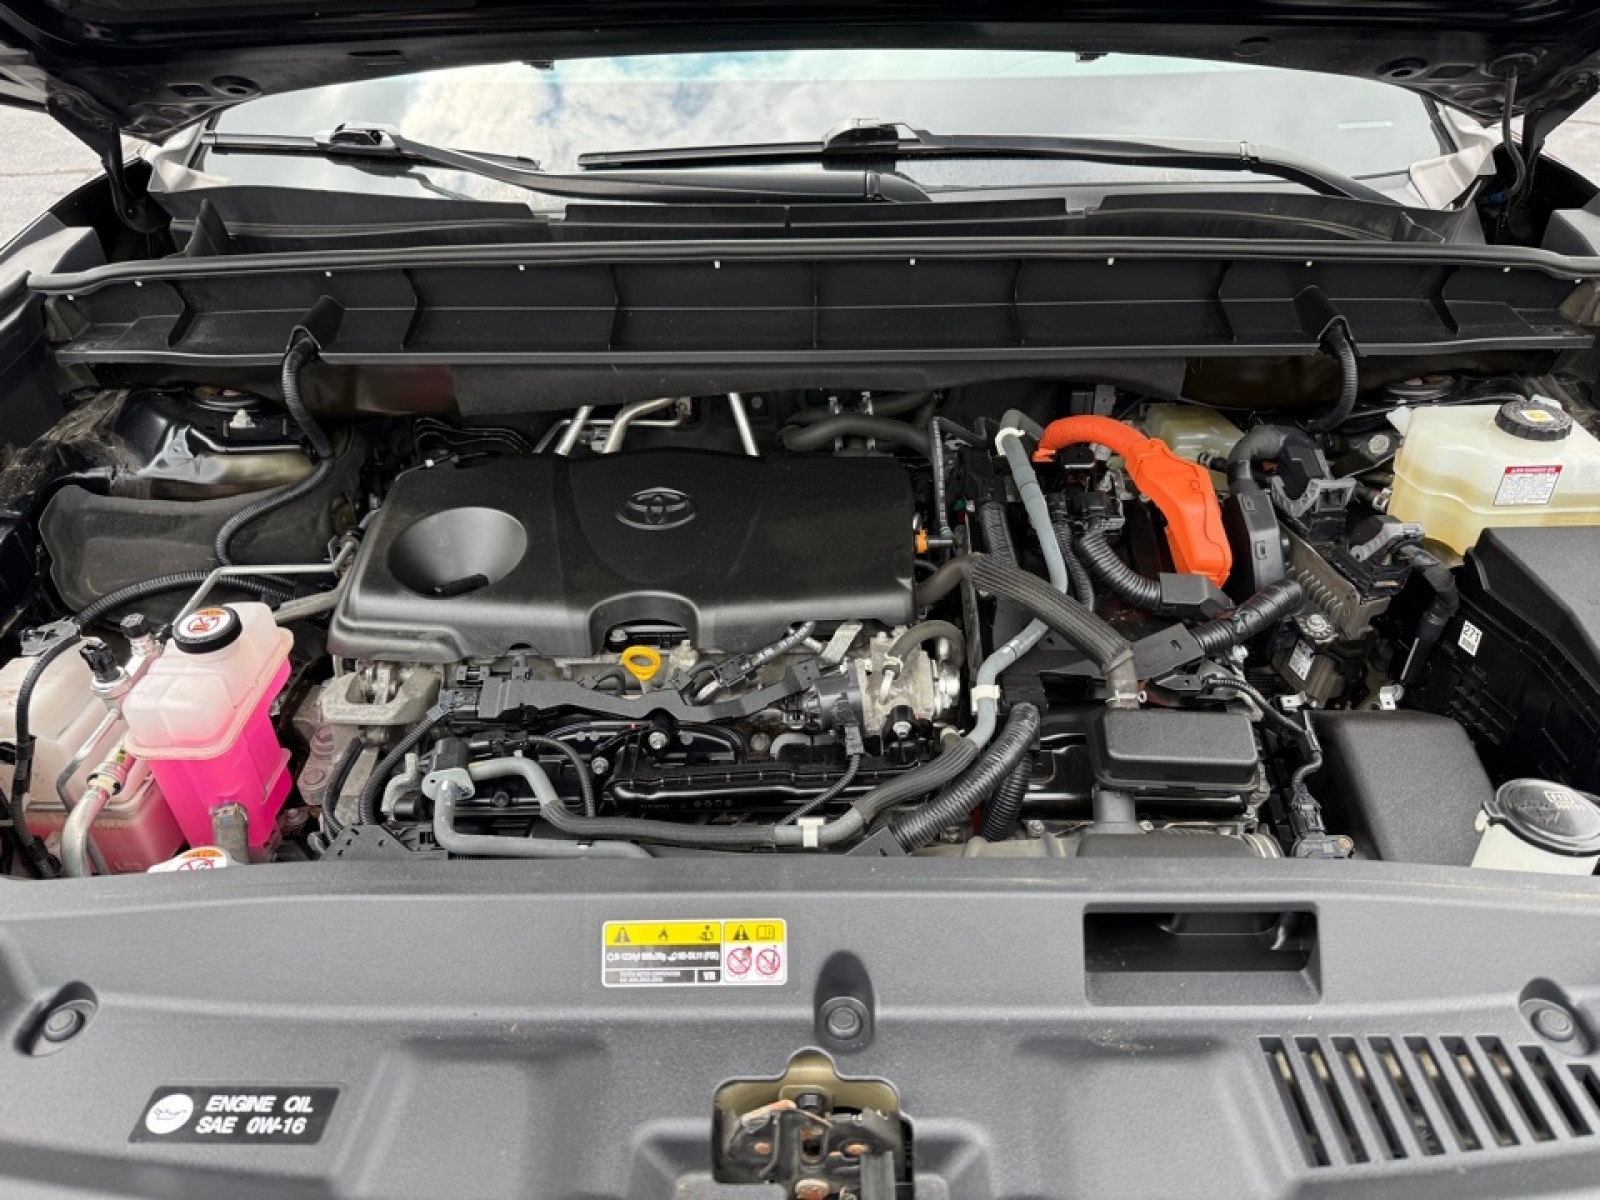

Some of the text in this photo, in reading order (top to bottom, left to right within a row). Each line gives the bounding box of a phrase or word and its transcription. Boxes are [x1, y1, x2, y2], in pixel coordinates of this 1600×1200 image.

[205, 1095, 314, 1113] ENGINE OIL
[195, 1116, 308, 1134] SAE 0W-16
